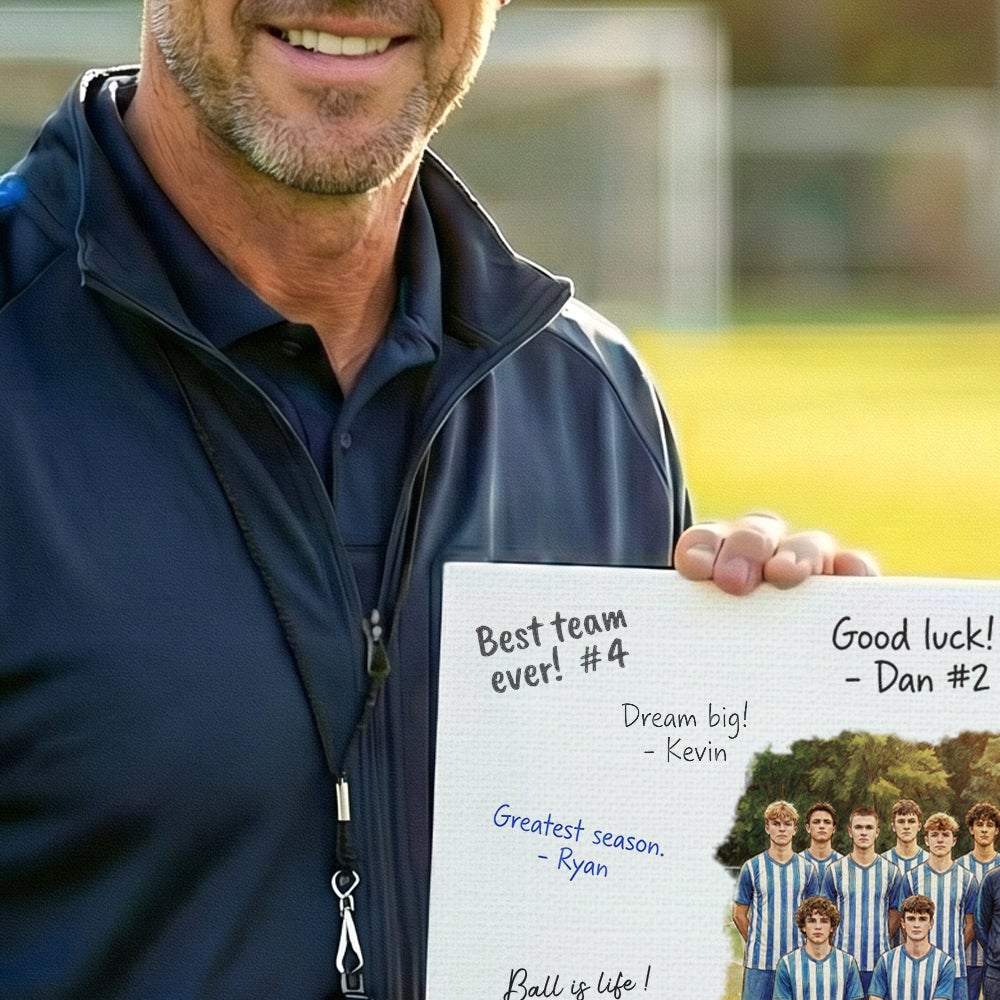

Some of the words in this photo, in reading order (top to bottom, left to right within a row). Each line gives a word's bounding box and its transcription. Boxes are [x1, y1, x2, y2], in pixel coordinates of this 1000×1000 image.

[474, 615, 545, 658] Best
[549, 609, 628, 643] team
[831, 615, 911, 652] Good
[924, 614, 995, 652] luck!
[491, 645, 563, 694] ever!
[579, 637, 630, 674] #4
[873, 659, 934, 694] Dan
[946, 662, 991, 693] #2
[621, 702, 697, 729] Dream
[708, 700, 748, 745] big!
[667, 736, 727, 764] Kevin
[493, 803, 586, 843] Greatest
[591, 829, 665, 858] season.
[557, 846, 608, 882] Ryan
[596, 970, 637, 1000] life
